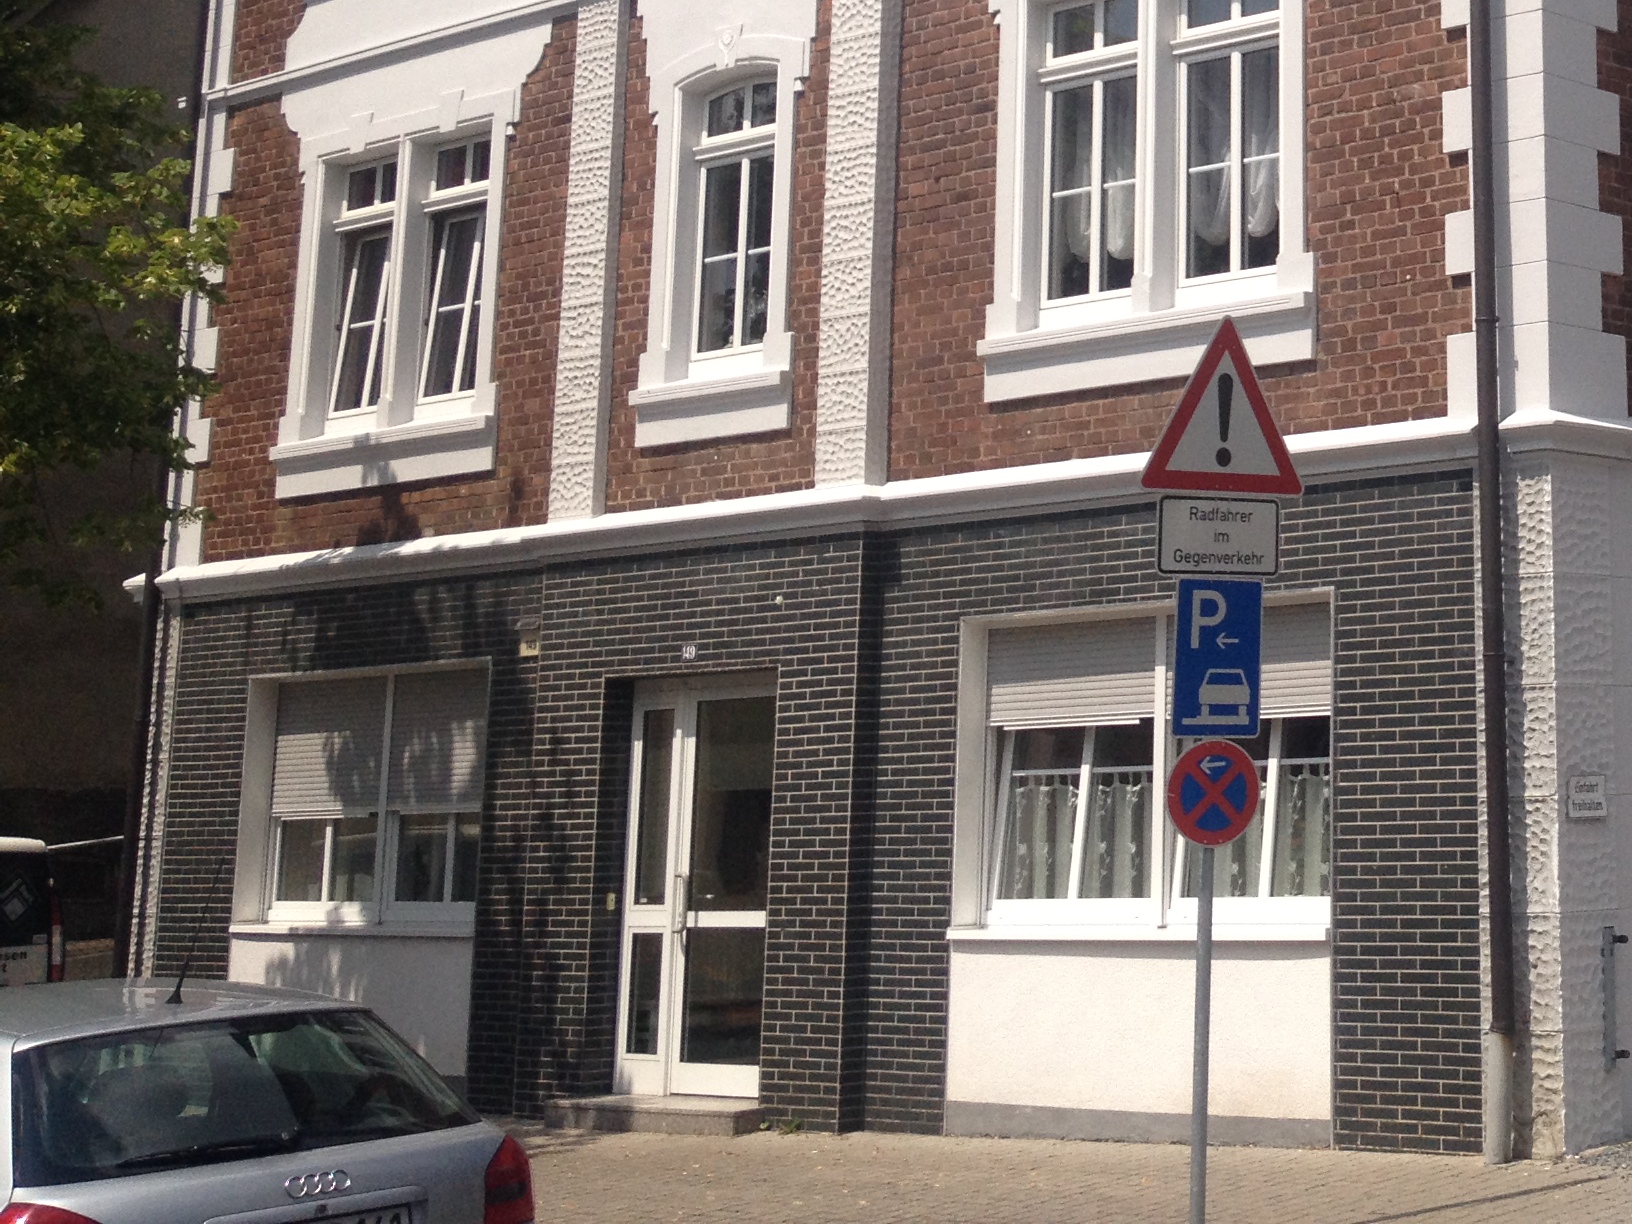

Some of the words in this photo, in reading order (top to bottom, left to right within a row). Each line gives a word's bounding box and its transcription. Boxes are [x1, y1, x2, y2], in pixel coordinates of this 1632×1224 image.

[1189, 506, 1253, 523] Radfahrer
[1213, 531, 1230, 543] im
[1173, 548, 1264, 567] Gegenverkehr
[1190, 589, 1227, 649] P
[682, 645, 696, 660] 149
